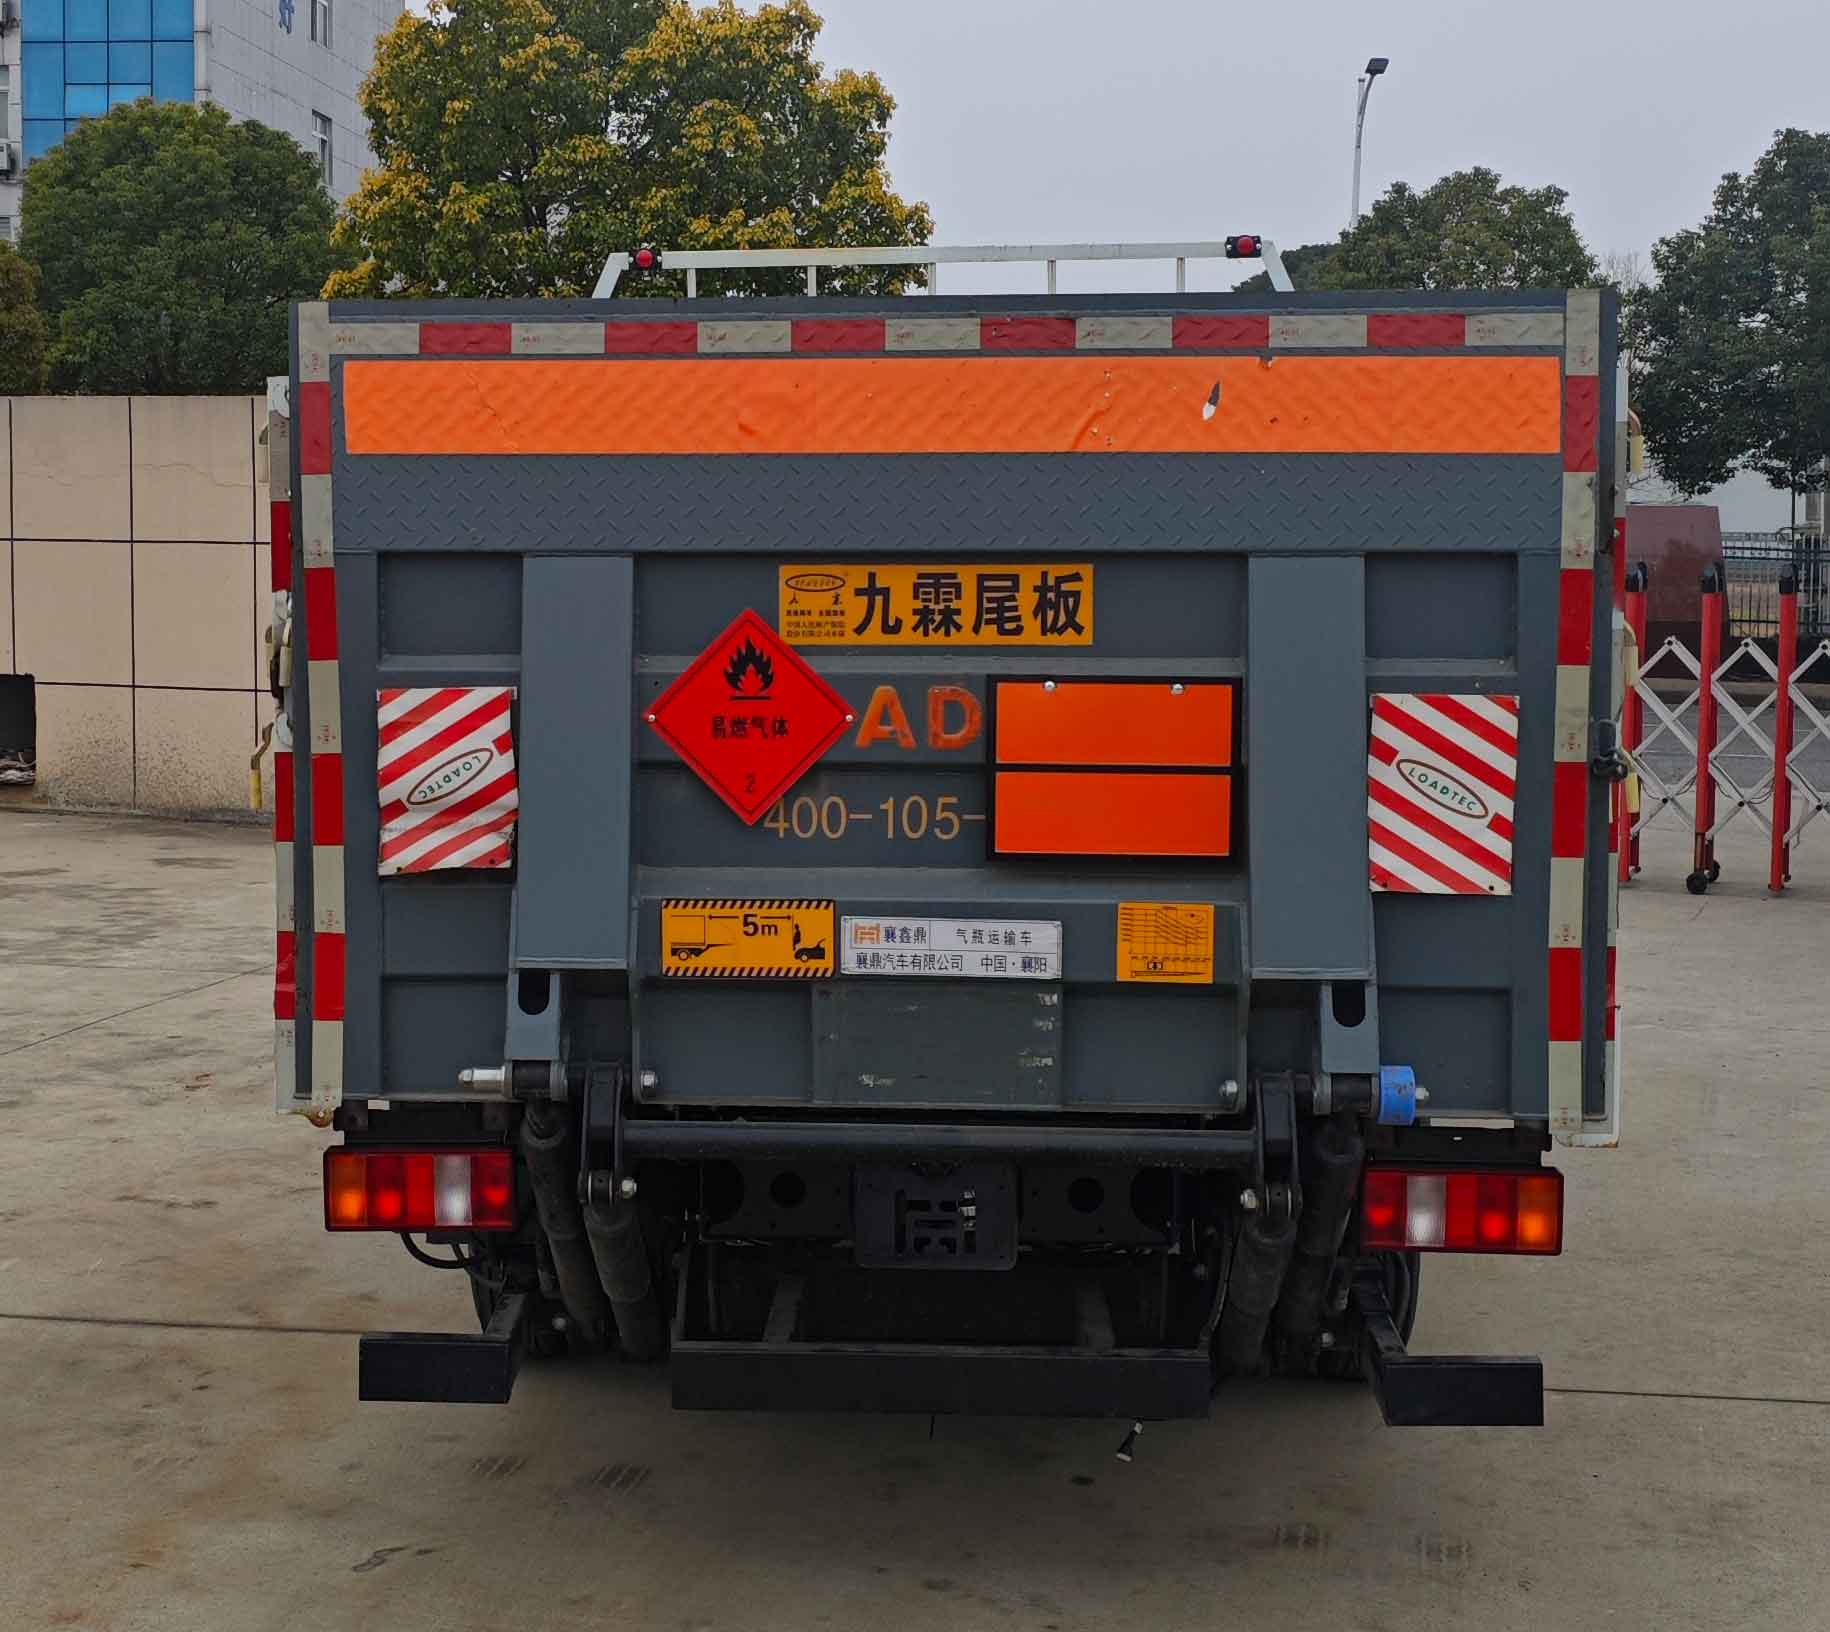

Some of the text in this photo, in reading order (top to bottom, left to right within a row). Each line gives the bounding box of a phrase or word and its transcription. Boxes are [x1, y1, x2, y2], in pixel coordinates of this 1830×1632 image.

[853, 571, 1085, 637] 九霖尾板
[712, 716, 789, 739] 易燃气体
[418, 754, 482, 800] LOADTEC
[744, 772, 756, 794] 2
[1408, 766, 1478, 812] LOADTEC
[742, 913, 778, 937] 5m
[883, 926, 927, 944] 襄鑫鼎
[956, 928, 1033, 947] 气瓶运输车
[855, 952, 964, 972] 襄鼎汽车有限公司
